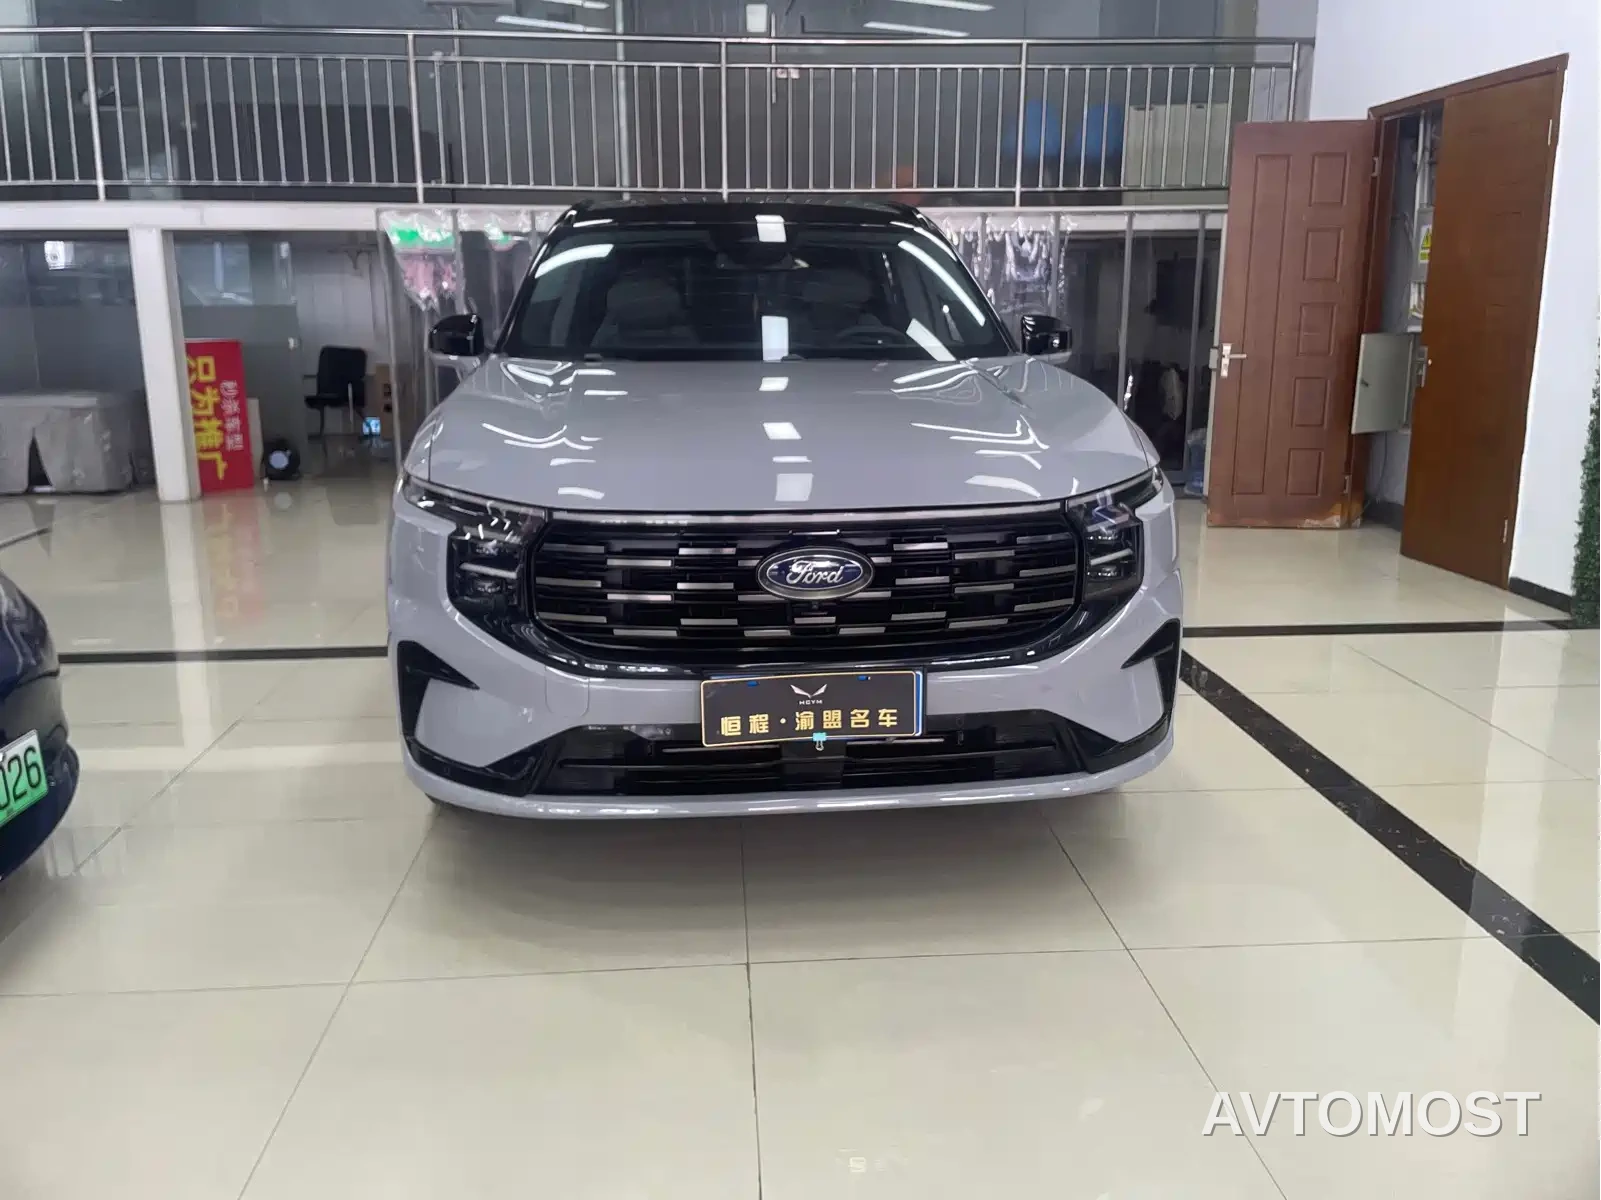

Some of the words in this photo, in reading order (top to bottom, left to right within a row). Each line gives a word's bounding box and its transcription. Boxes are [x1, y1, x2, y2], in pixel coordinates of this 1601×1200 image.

[185, 355, 227, 480] 只为推广
[786, 559, 844, 584] Ford
